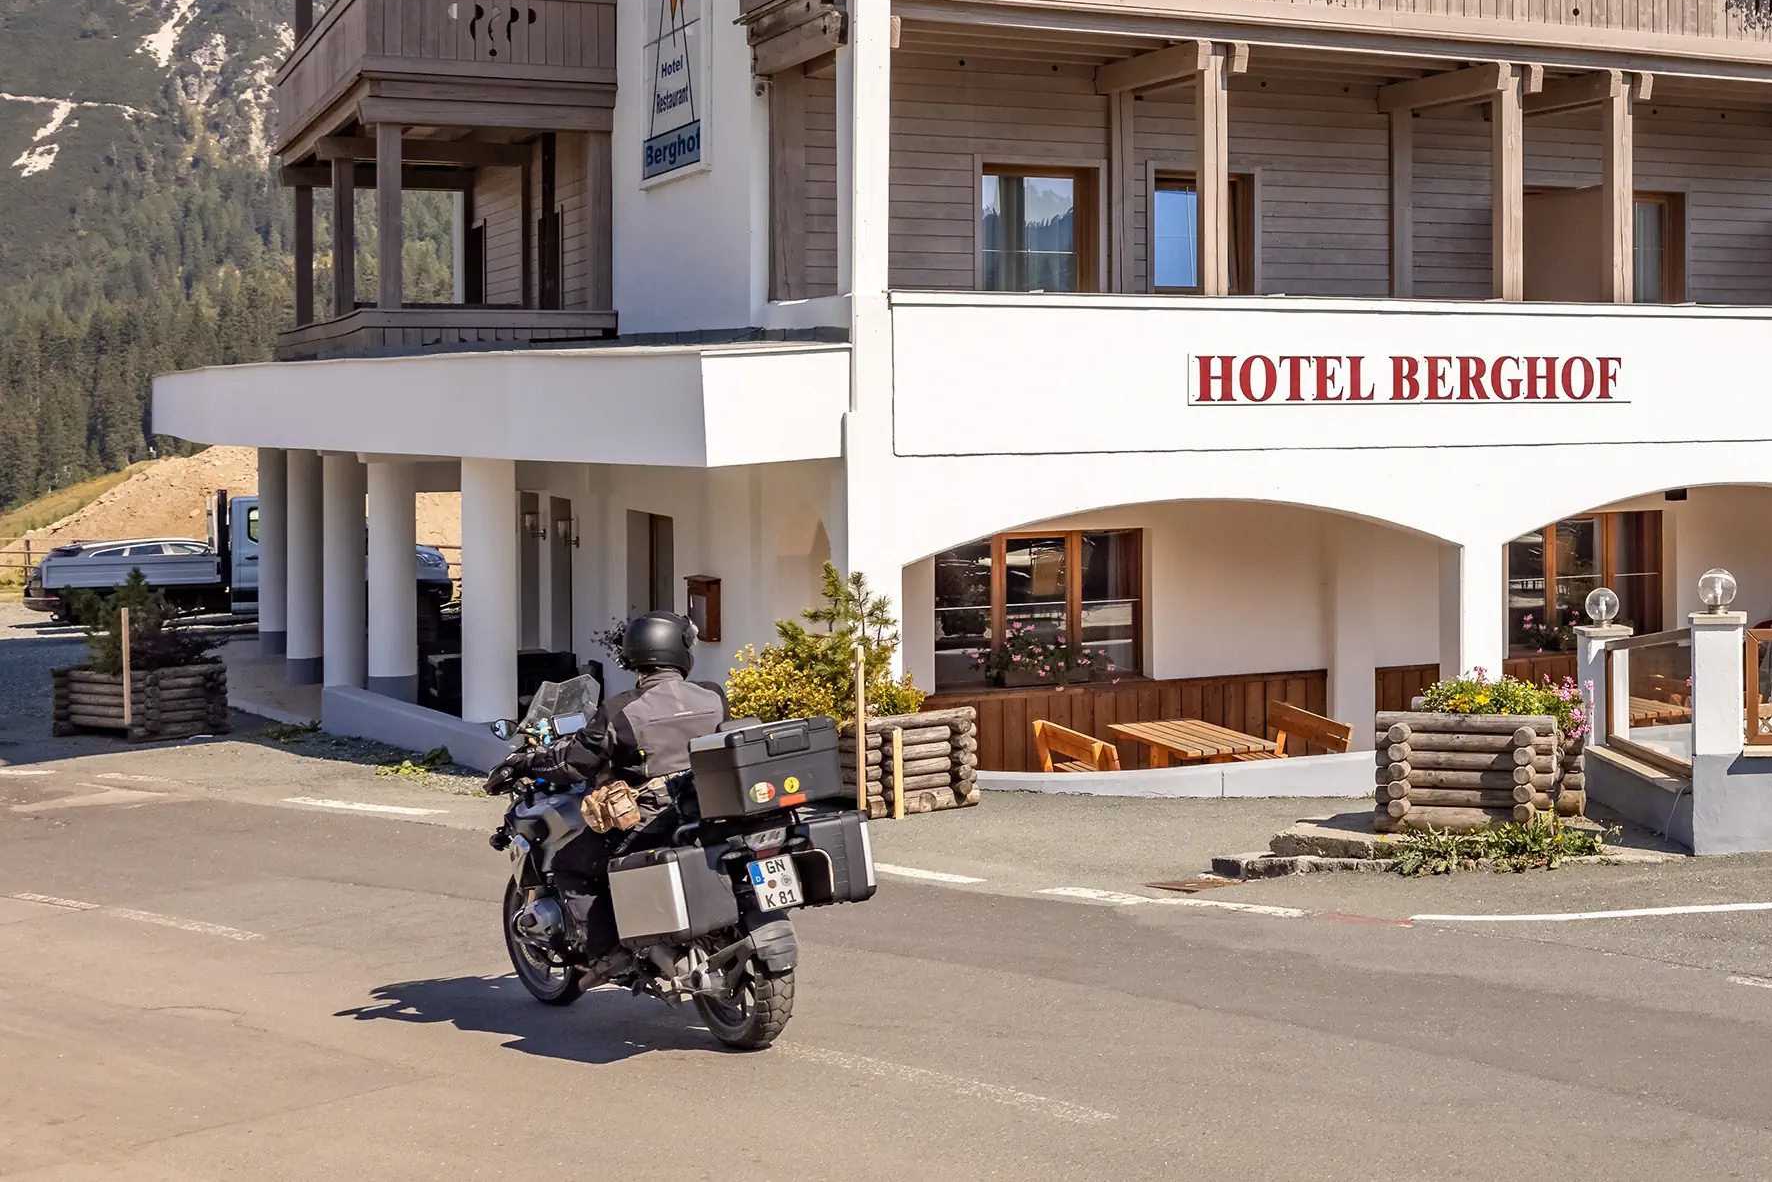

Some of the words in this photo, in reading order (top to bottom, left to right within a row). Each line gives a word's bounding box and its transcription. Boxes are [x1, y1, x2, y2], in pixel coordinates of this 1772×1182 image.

[661, 54, 683, 78] Hotel
[656, 82, 689, 114] Restaurant
[1195, 355, 1375, 401] HOTEL
[1389, 355, 1622, 400] BERGHOF
[765, 859, 786, 874] GN
[765, 894, 776, 908] K
[779, 889, 797, 905] 81
